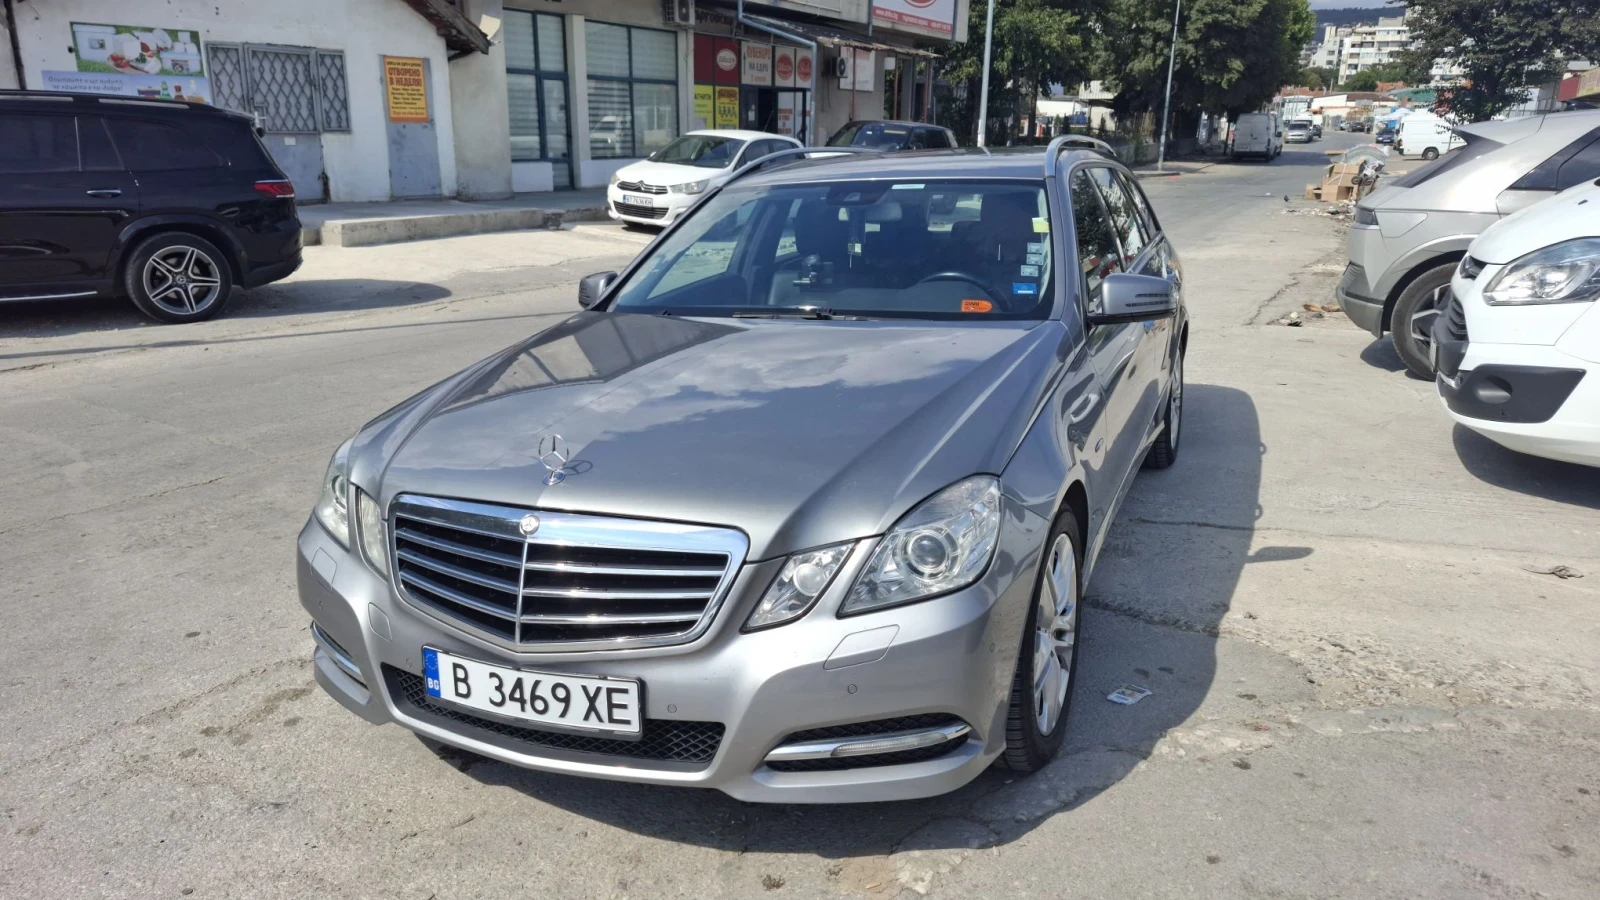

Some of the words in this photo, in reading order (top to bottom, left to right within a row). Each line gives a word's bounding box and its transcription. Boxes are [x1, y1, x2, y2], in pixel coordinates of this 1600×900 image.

[388, 67, 421, 77] ОТВОРЕНО
[749, 62, 755, 71] НА
[756, 63, 769, 73] ЕДРО
[389, 77, 394, 85] В
[427, 677, 440, 690] BG
[452, 662, 472, 699] B
[488, 672, 572, 719] 3469
[581, 684, 632, 725] XE
